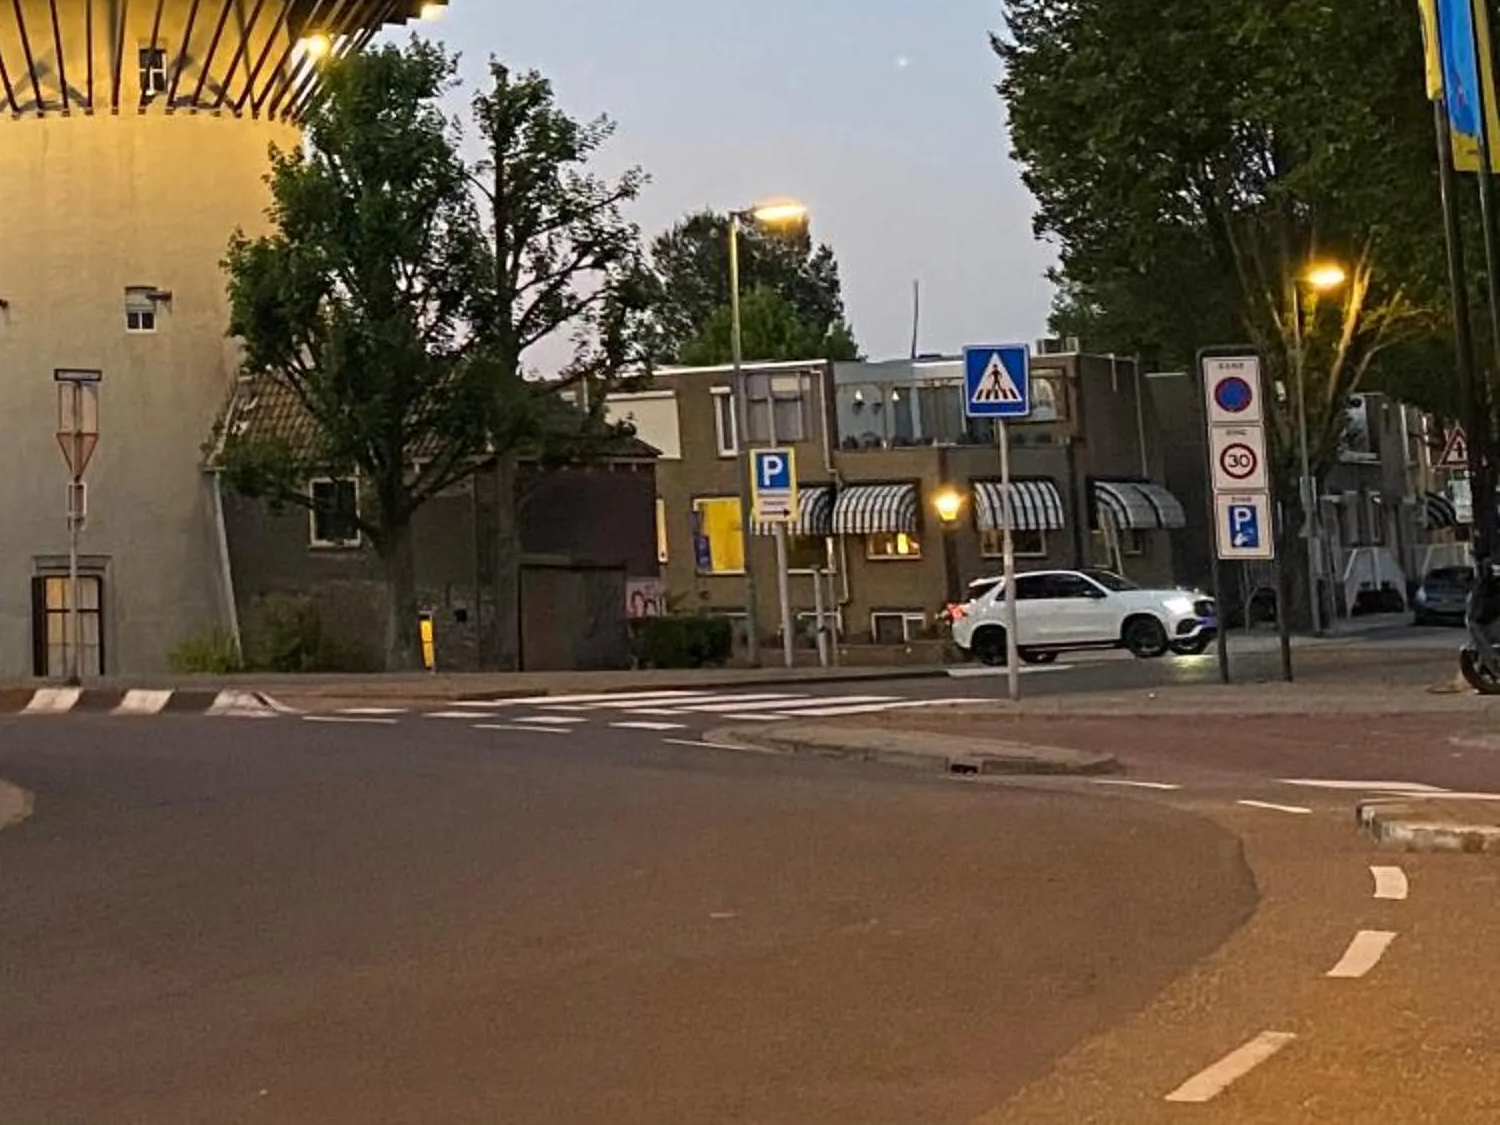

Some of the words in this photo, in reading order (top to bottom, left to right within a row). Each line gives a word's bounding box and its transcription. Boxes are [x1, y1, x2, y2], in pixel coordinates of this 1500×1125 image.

[763, 455, 783, 486] P
[1227, 454, 1251, 468] 30
[1234, 507, 1252, 532] P
